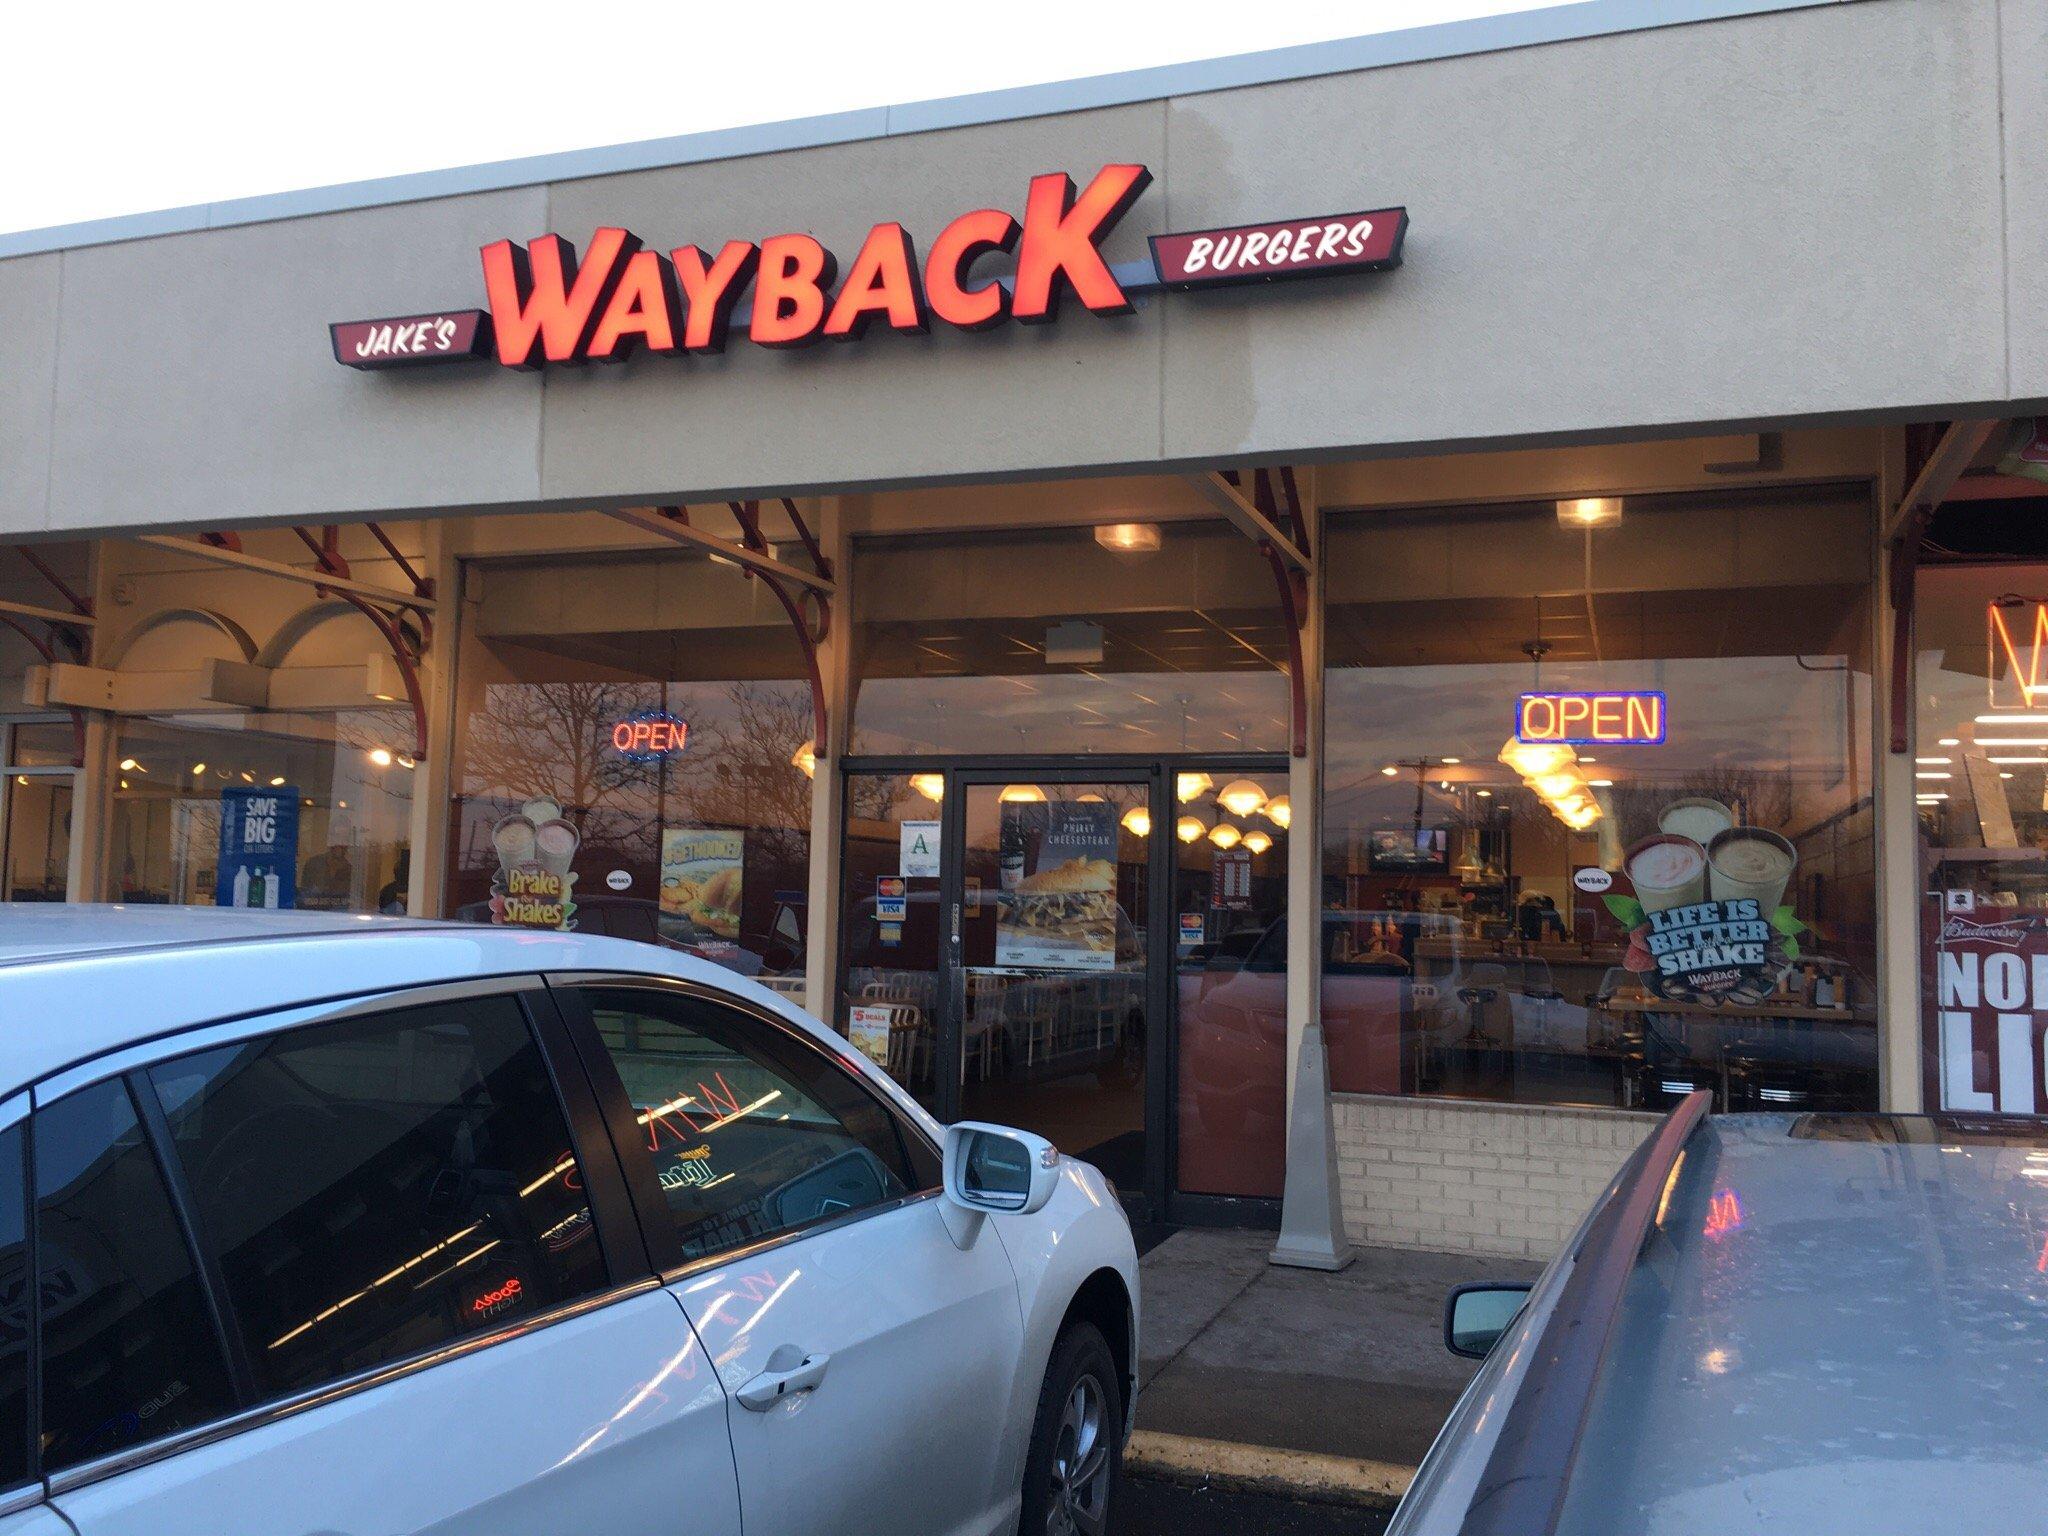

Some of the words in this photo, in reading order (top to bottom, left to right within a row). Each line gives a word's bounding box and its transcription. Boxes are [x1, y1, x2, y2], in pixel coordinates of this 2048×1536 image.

[1183, 219, 1374, 274] BURGERS
[480, 164, 1152, 368] WAYBACK
[355, 315, 457, 358] JAKE'S
[1521, 695, 1661, 741] OPEN
[612, 722, 689, 751] OPEN
[245, 797, 278, 816] SAVE
[244, 816, 276, 844] BIG
[1048, 835, 1110, 846] CHEESESTEAK
[1063, 823, 1096, 834] PHILLY
[910, 832, 930, 855] A
[508, 869, 560, 896] Brake
[1576, 876, 1610, 885] WAYBACK
[503, 897, 562, 925] Shakes
[881, 903, 901, 914] VISA
[1647, 901, 1720, 933] LIFE
[1724, 899, 1759, 920] IS
[1646, 920, 1770, 955] BETTER
[1658, 943, 1764, 976] SHAKE
[1687, 968, 1741, 985] WAYBACK
